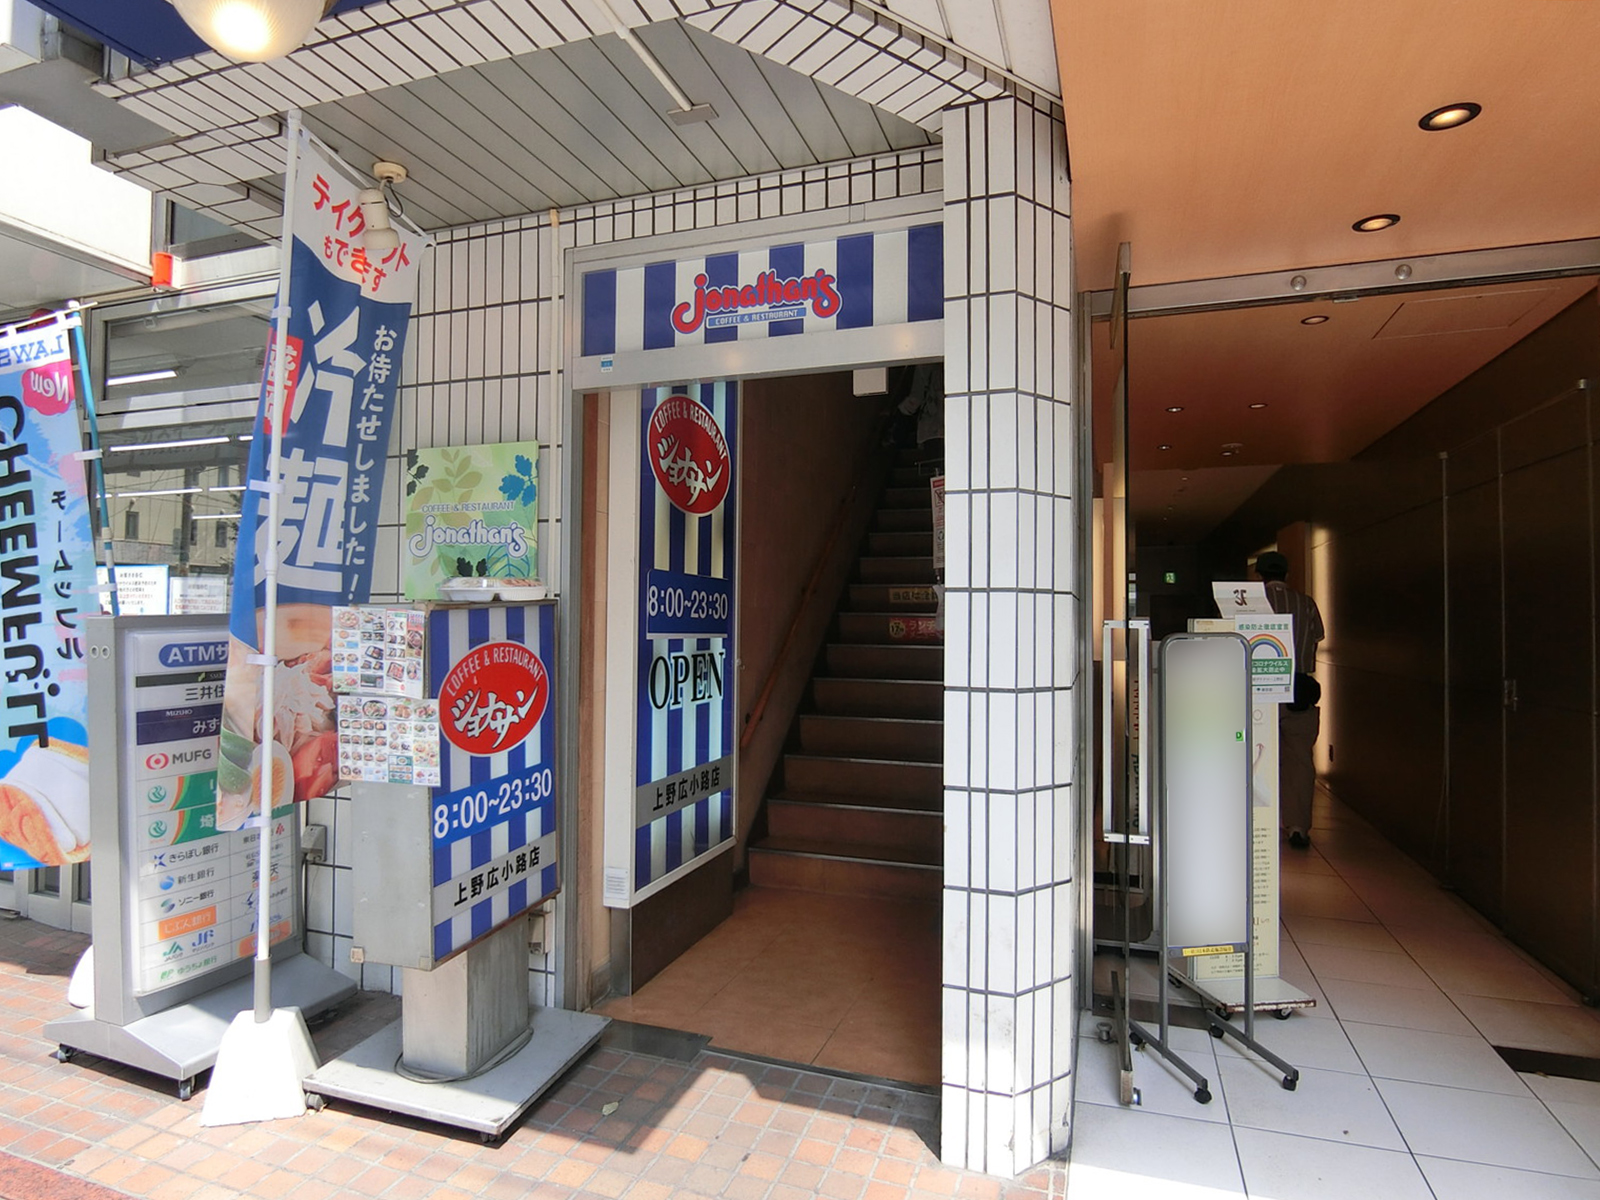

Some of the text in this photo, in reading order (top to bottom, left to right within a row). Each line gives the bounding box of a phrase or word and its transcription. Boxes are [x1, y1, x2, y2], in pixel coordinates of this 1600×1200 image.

[312, 173, 411, 272] テイクト
[323, 235, 387, 292] もできます
[715, 310, 799, 326] COFFEE & RESTAURANT
[654, 401, 728, 460] COFFEE & RESTAURANT
[657, 434, 723, 507] ジョナサン
[422, 501, 515, 513] COFFEE & RESTAURANT
[446, 646, 544, 697] COFFEE & RESTAURANT
[649, 651, 725, 710] OPEN
[165, 708, 193, 717] MIZUHO
[451, 685, 539, 748] ジョナサン
[172, 748, 212, 764] MUFG
[653, 766, 721, 811] 上野広小路店
[168, 843, 219, 864] きらぼし銀行
[177, 867, 215, 885] 新生銀行
[454, 846, 540, 907] 上野広小路店
[178, 889, 215, 907] ソニー銀行
